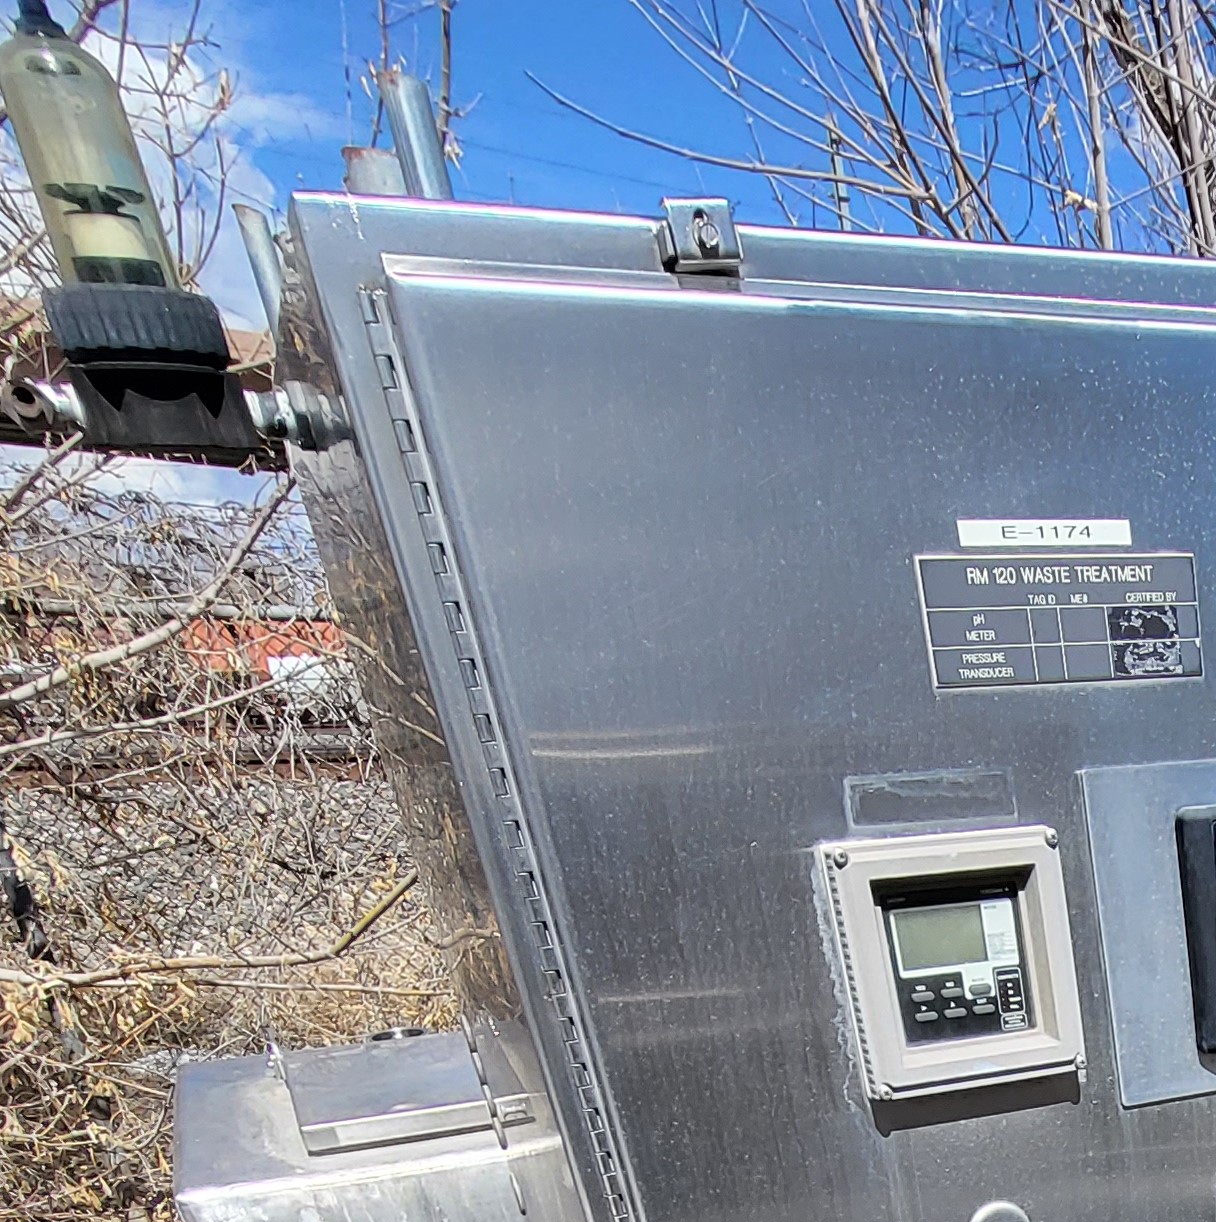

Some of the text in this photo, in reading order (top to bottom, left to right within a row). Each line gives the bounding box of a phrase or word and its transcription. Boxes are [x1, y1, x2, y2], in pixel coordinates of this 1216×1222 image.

[1001, 525, 1093, 539] E-1174
[966, 565, 1153, 585] RM 120 WASTE TREATMENT
[1027, 594, 1056, 605] TAG ID
[1126, 591, 1177, 603] CERTIFIED BY
[972, 613, 985, 627] pH
[965, 629, 996, 641] METER
[961, 652, 1006, 665] PRESSURE
[959, 667, 1015, 679] TRANSDUCER
